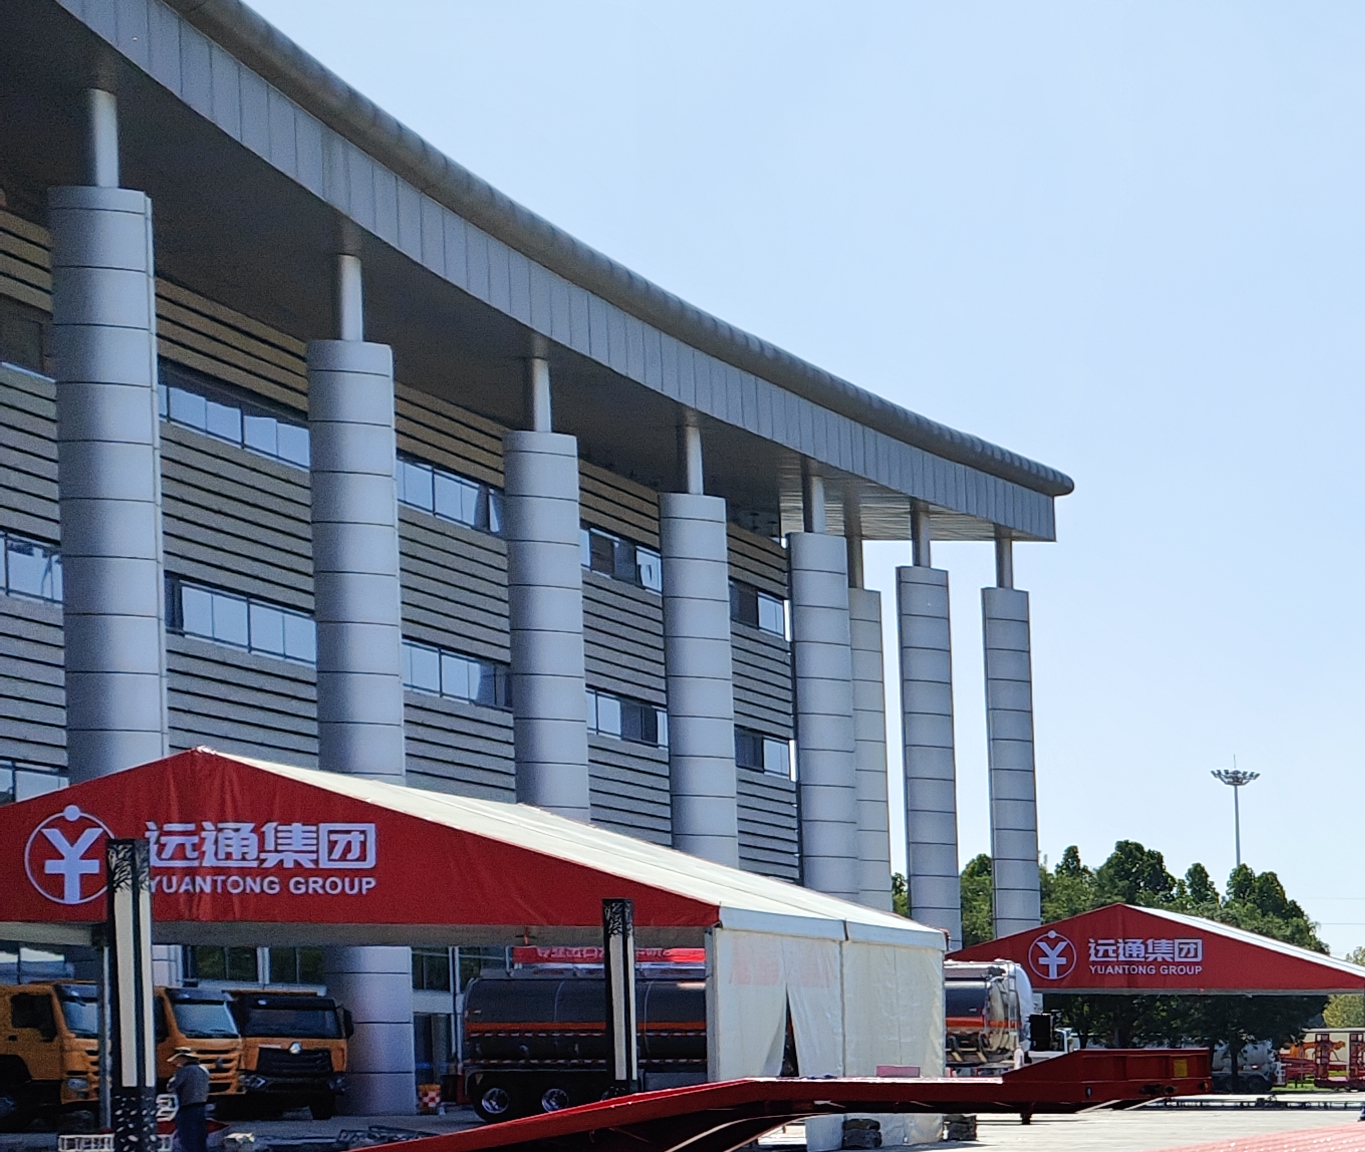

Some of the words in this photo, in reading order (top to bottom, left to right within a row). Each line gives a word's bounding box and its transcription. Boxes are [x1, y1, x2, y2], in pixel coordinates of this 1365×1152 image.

[145, 821, 376, 869] 远通集团
[150, 876, 280, 895] YUANTONG
[288, 876, 377, 895] GROUP
[1088, 938, 1203, 962] 远通集团
[1089, 965, 1156, 975] YUANTONG
[1160, 964, 1203, 975] GROUP
